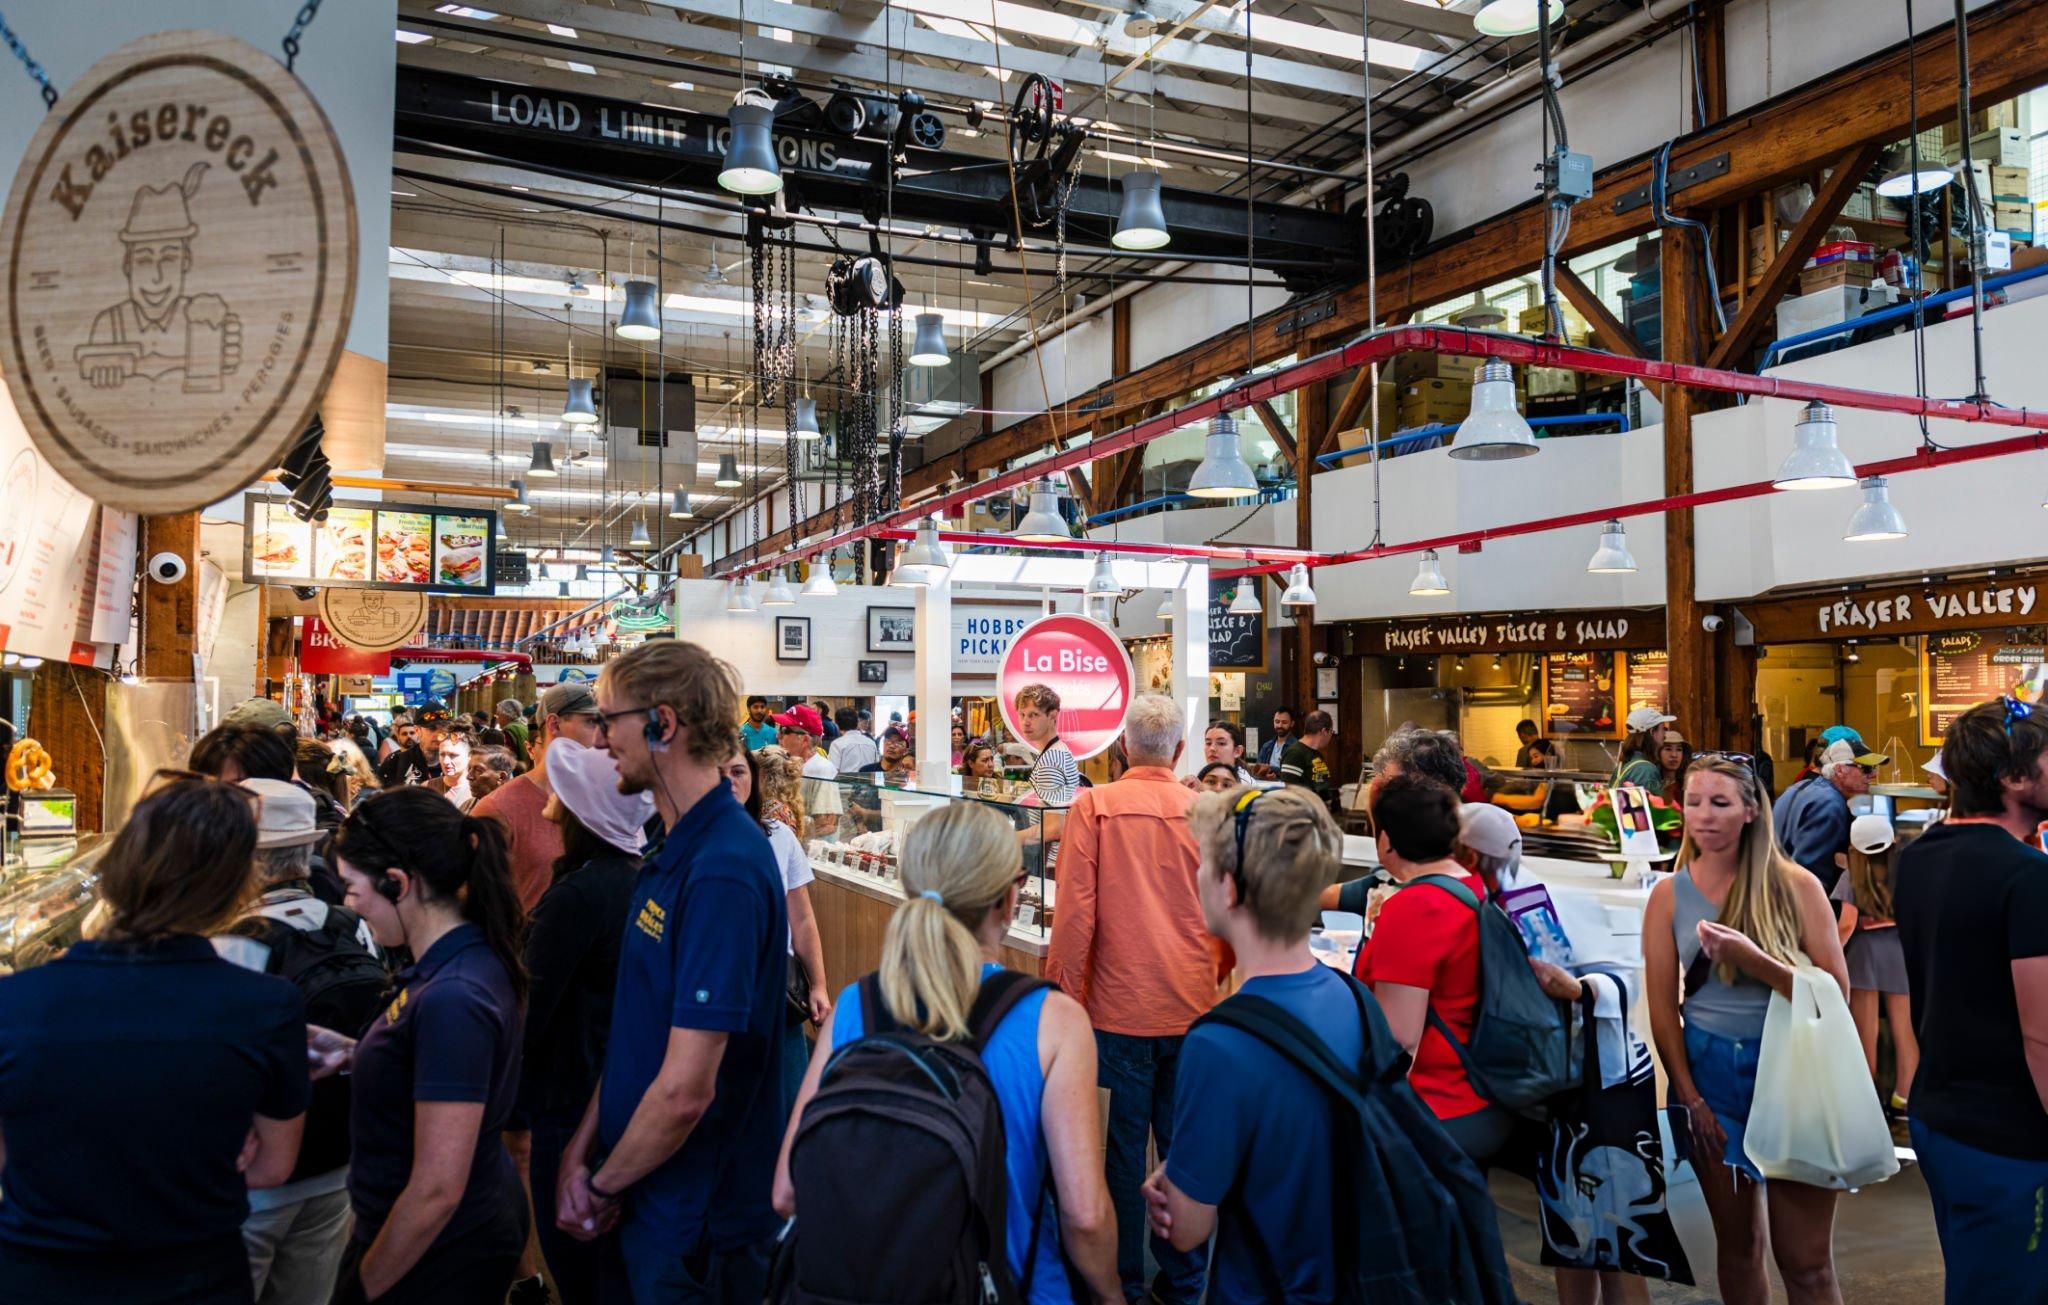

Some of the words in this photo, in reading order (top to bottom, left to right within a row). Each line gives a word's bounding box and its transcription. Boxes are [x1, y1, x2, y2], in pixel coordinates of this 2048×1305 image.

[491, 91, 581, 132] LOAD
[600, 107, 687, 148] LIMIT
[50, 101, 280, 222] Kaisereck
[55, 386, 119, 449] SAUSAGES
[241, 310, 296, 404] PEROGIES
[968, 618, 1025, 635] HOBBS
[1819, 595, 1912, 632] FRASER
[1928, 586, 2036, 619] VALLEY
[1385, 626, 1431, 650] FRASER
[1437, 625, 1488, 645] VALLEY
[1496, 621, 1547, 644] JUICE
[1556, 621, 1567, 640] &
[1576, 619, 1629, 644] SALAD
[1941, 636, 1972, 648] SALADS
[1023, 649, 1053, 673] La
[1059, 648, 1109, 673] Bise
